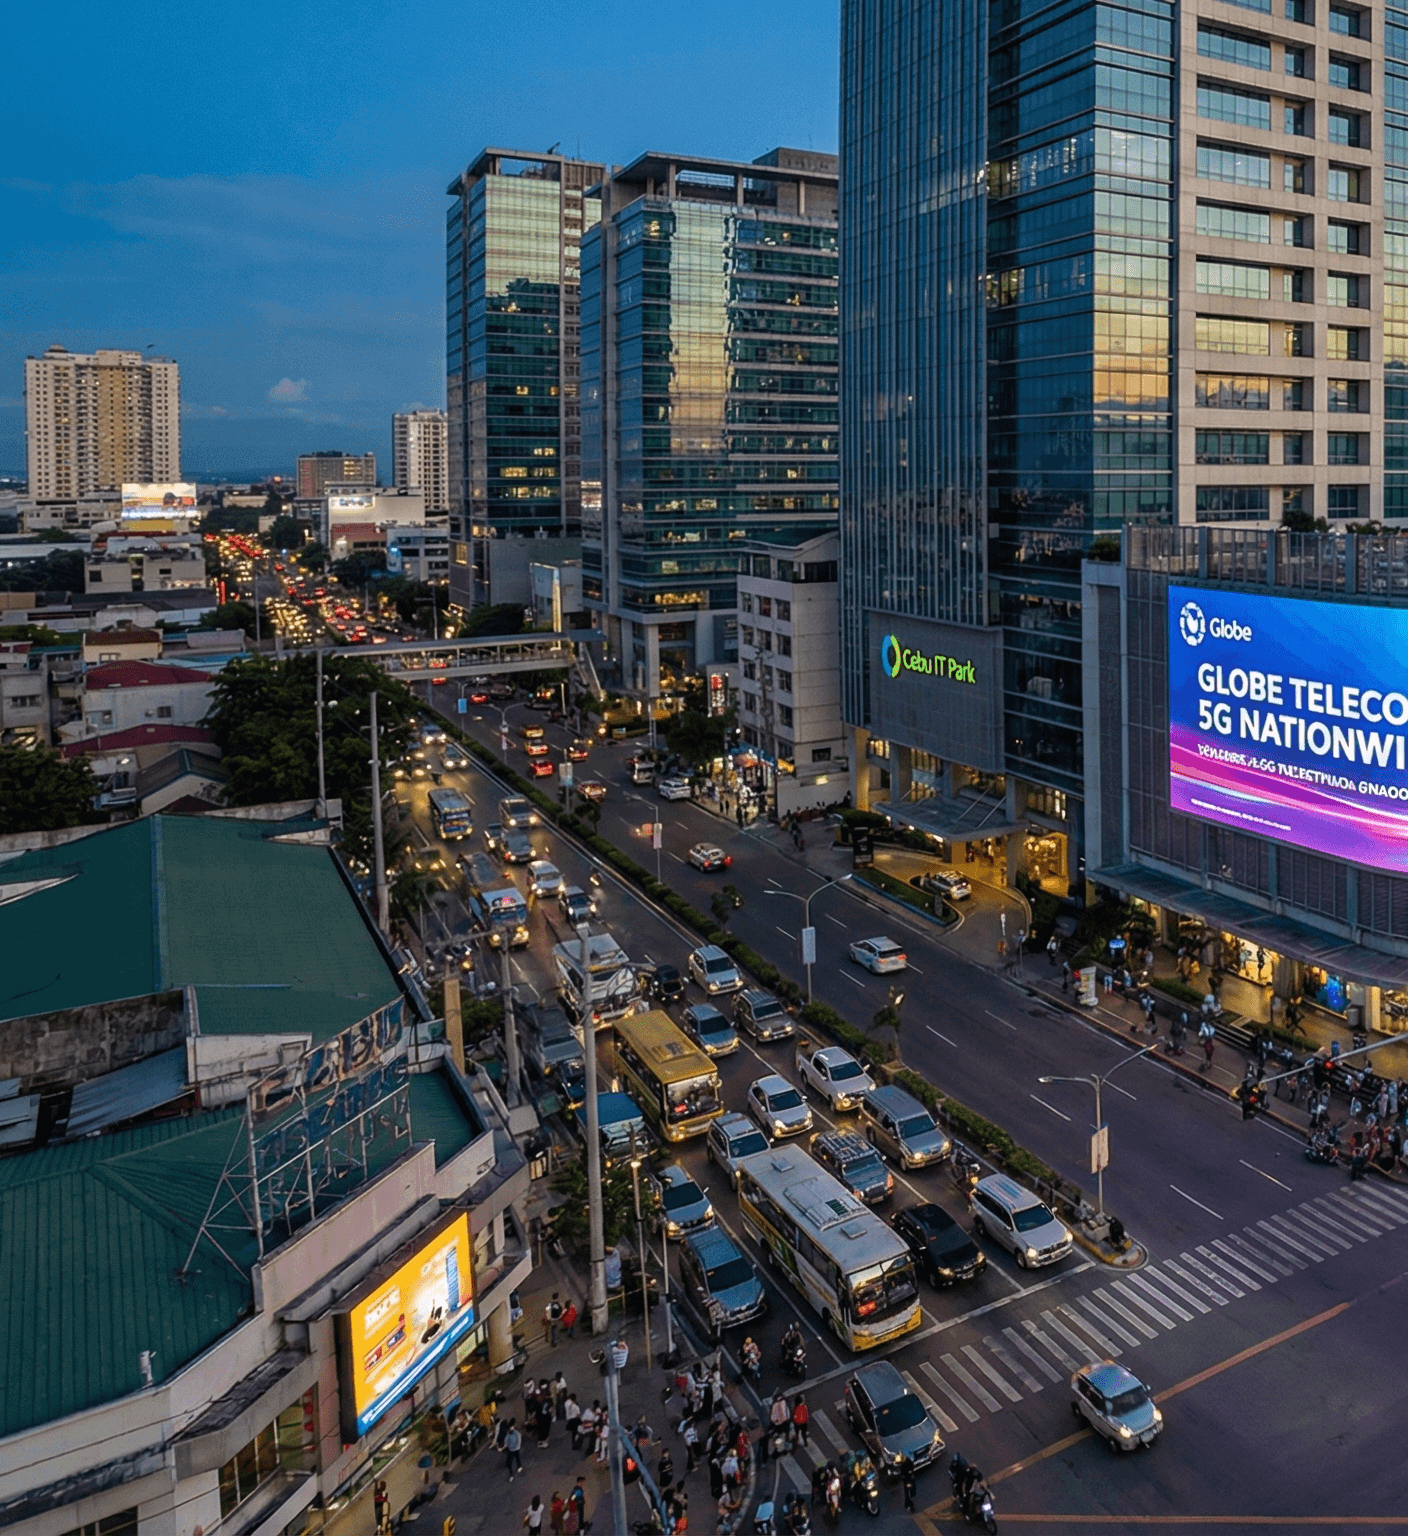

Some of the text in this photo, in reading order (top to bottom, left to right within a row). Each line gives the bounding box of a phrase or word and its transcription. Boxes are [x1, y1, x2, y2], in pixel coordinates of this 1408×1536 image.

[1209, 617, 1253, 642] Globe
[903, 649, 977, 684] Cebu IT Park
[1198, 662, 1283, 705] GLOBE
[1198, 699, 1232, 735] 5G
